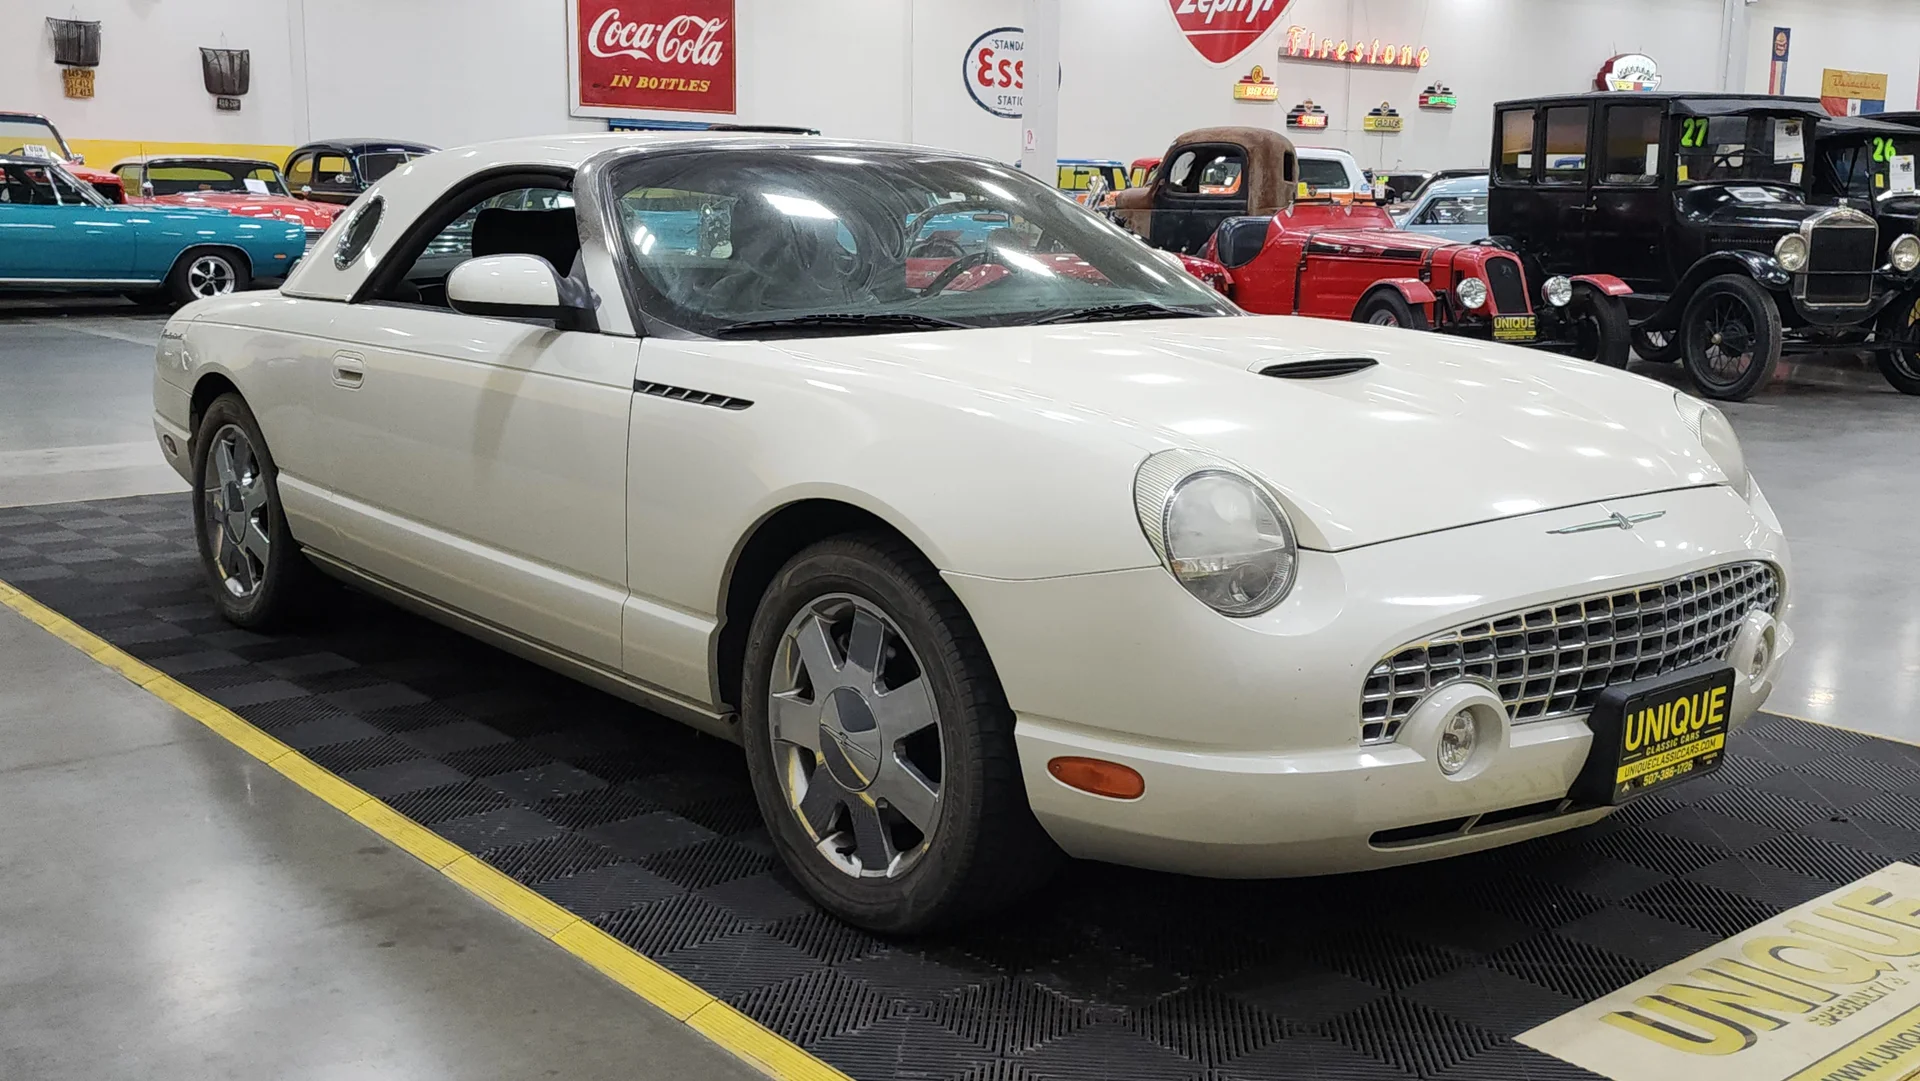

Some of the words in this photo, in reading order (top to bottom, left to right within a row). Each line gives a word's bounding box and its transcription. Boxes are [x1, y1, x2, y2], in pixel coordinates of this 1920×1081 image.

[588, 8, 728, 66] Coca-Cola
[1286, 25, 1430, 67] Firestone
[610, 75, 633, 88] IN
[636, 76, 711, 92] BOTTLES
[1681, 118, 1708, 147] 27
[1873, 137, 1896, 162] 26
[1494, 317, 1536, 329] UNIQUE
[1625, 686, 1727, 752] UNIQUE
[1624, 738, 1717, 778] UNIQUECLASSICCARS.COM
[1646, 738, 1679, 756] CLASSIC
[1680, 731, 1701, 744] CARS
